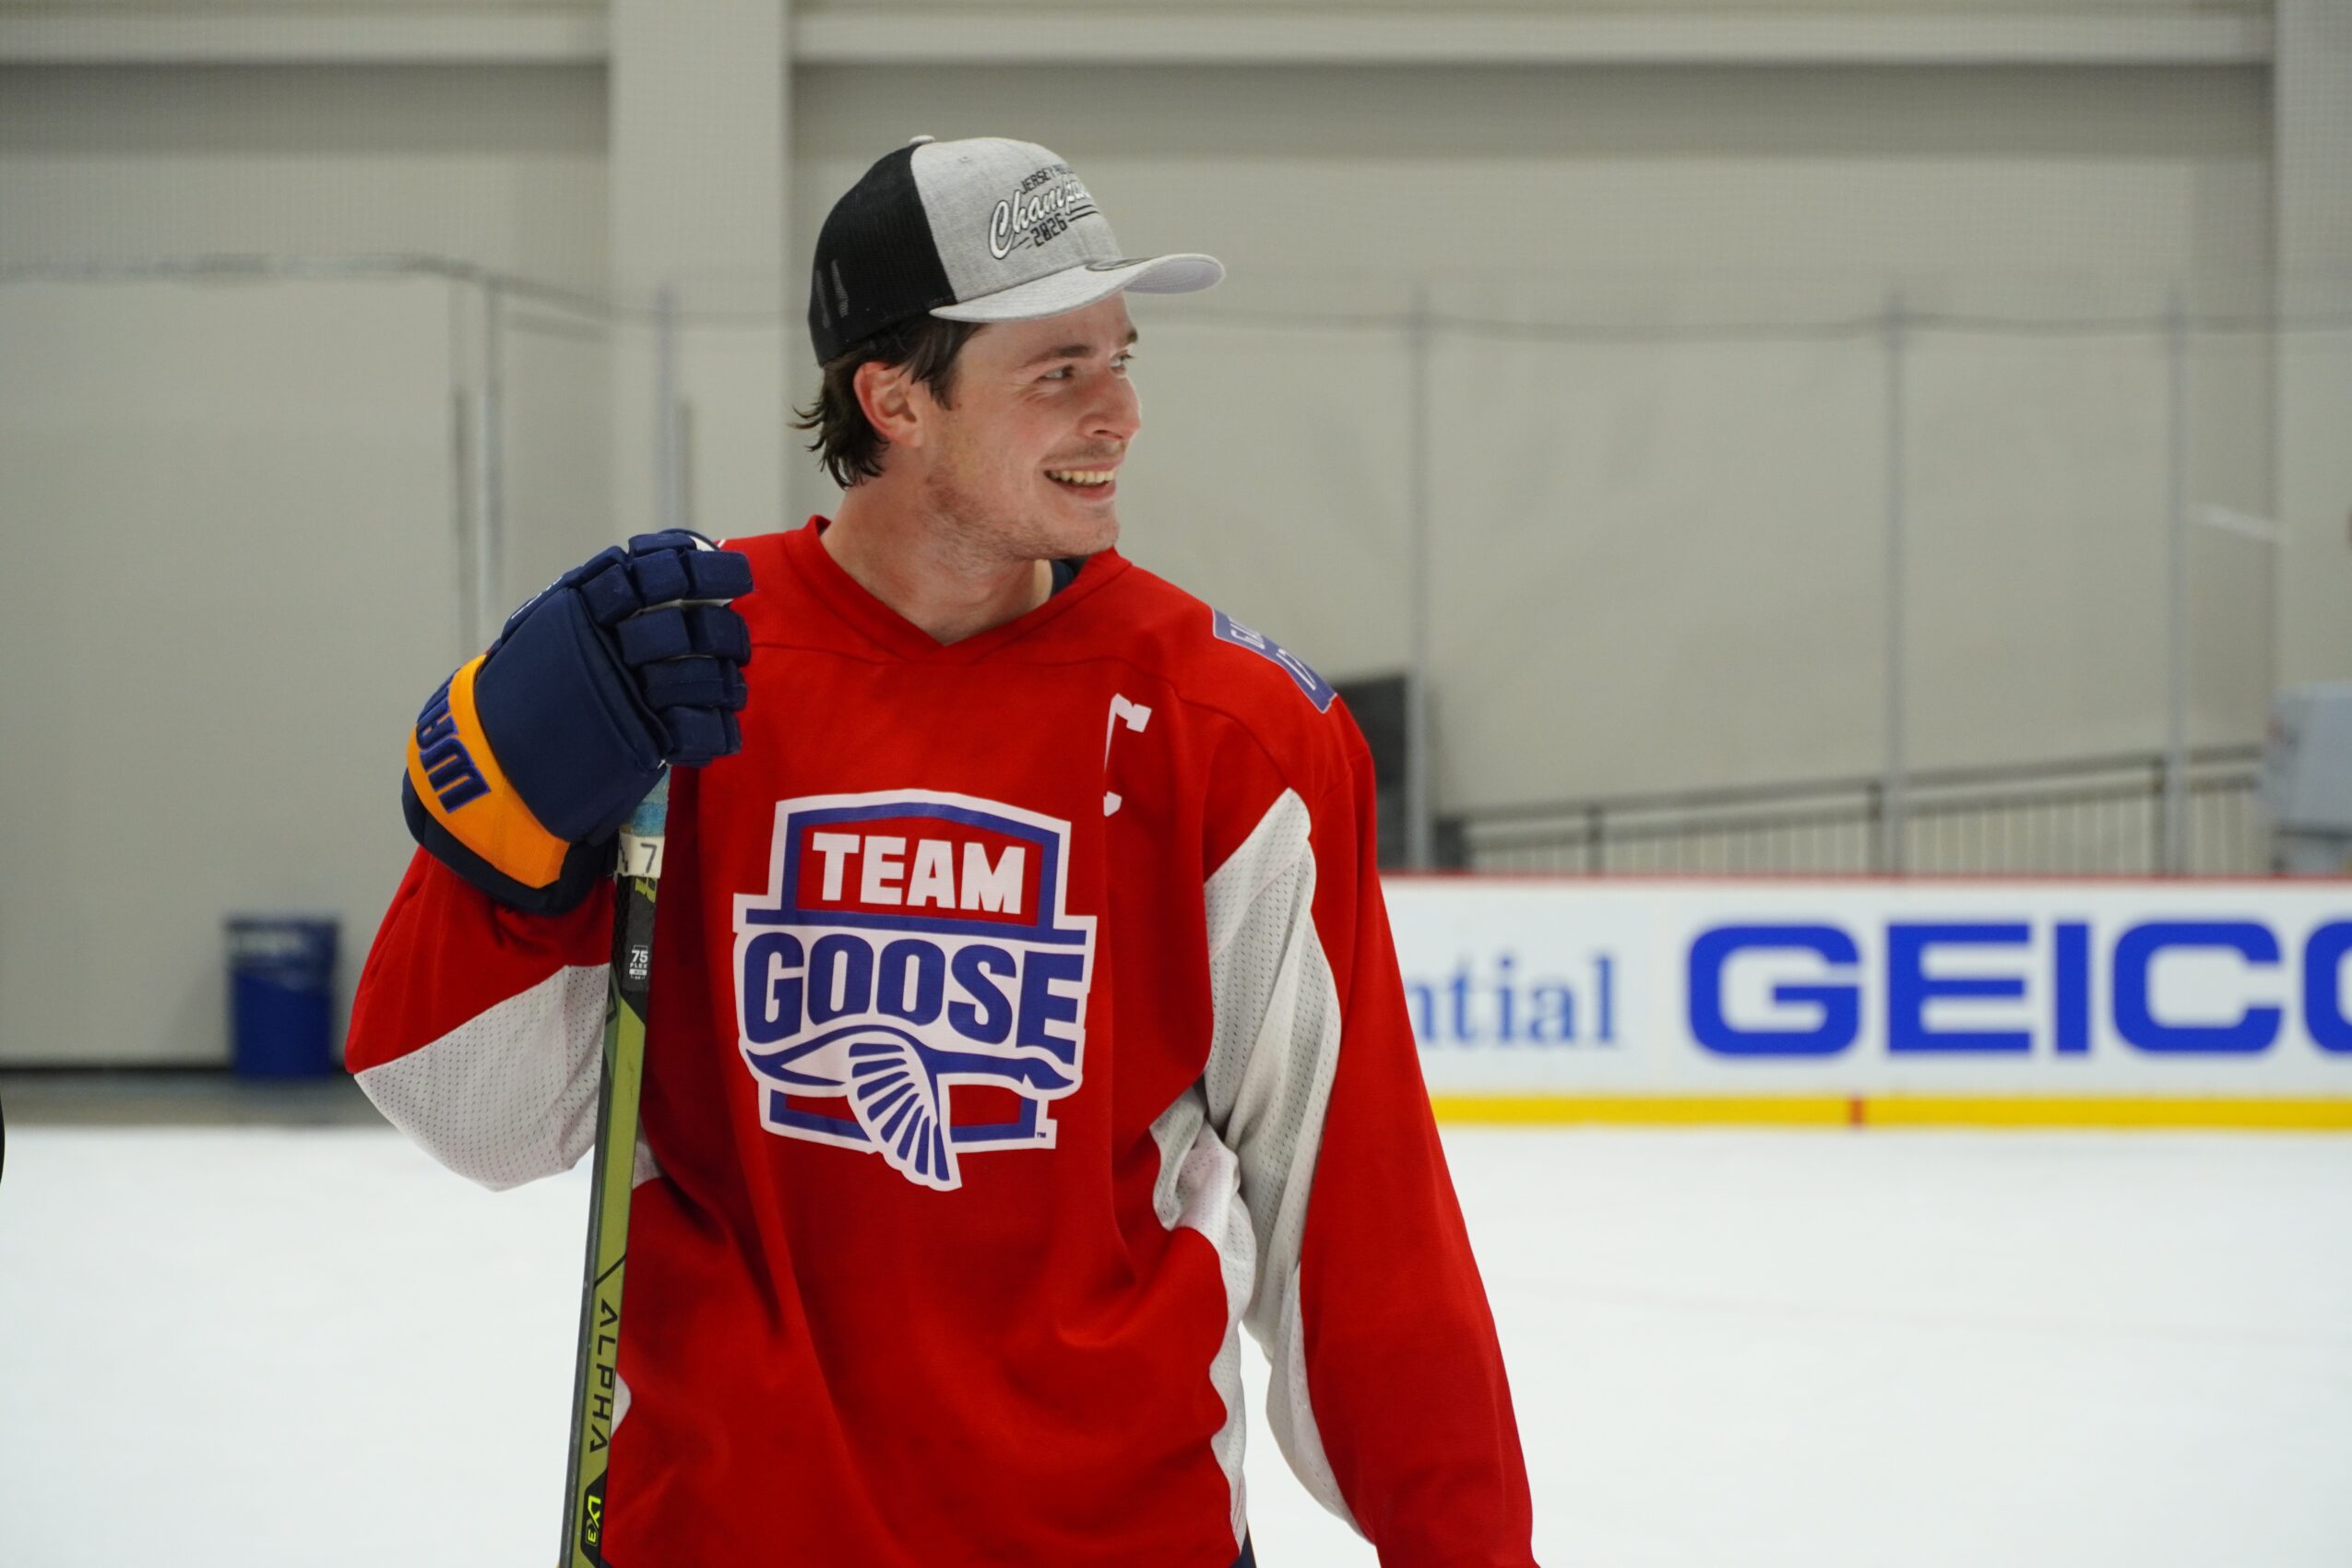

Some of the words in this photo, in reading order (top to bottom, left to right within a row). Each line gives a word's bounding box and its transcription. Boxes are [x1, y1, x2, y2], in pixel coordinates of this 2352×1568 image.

[813, 832, 1026, 915] TEAM
[631, 949, 648, 963] 75
[743, 932, 1085, 1065] GOOSE
[1688, 923, 2352, 1054] GEIC
[588, 1298, 619, 1454] ALPHA
